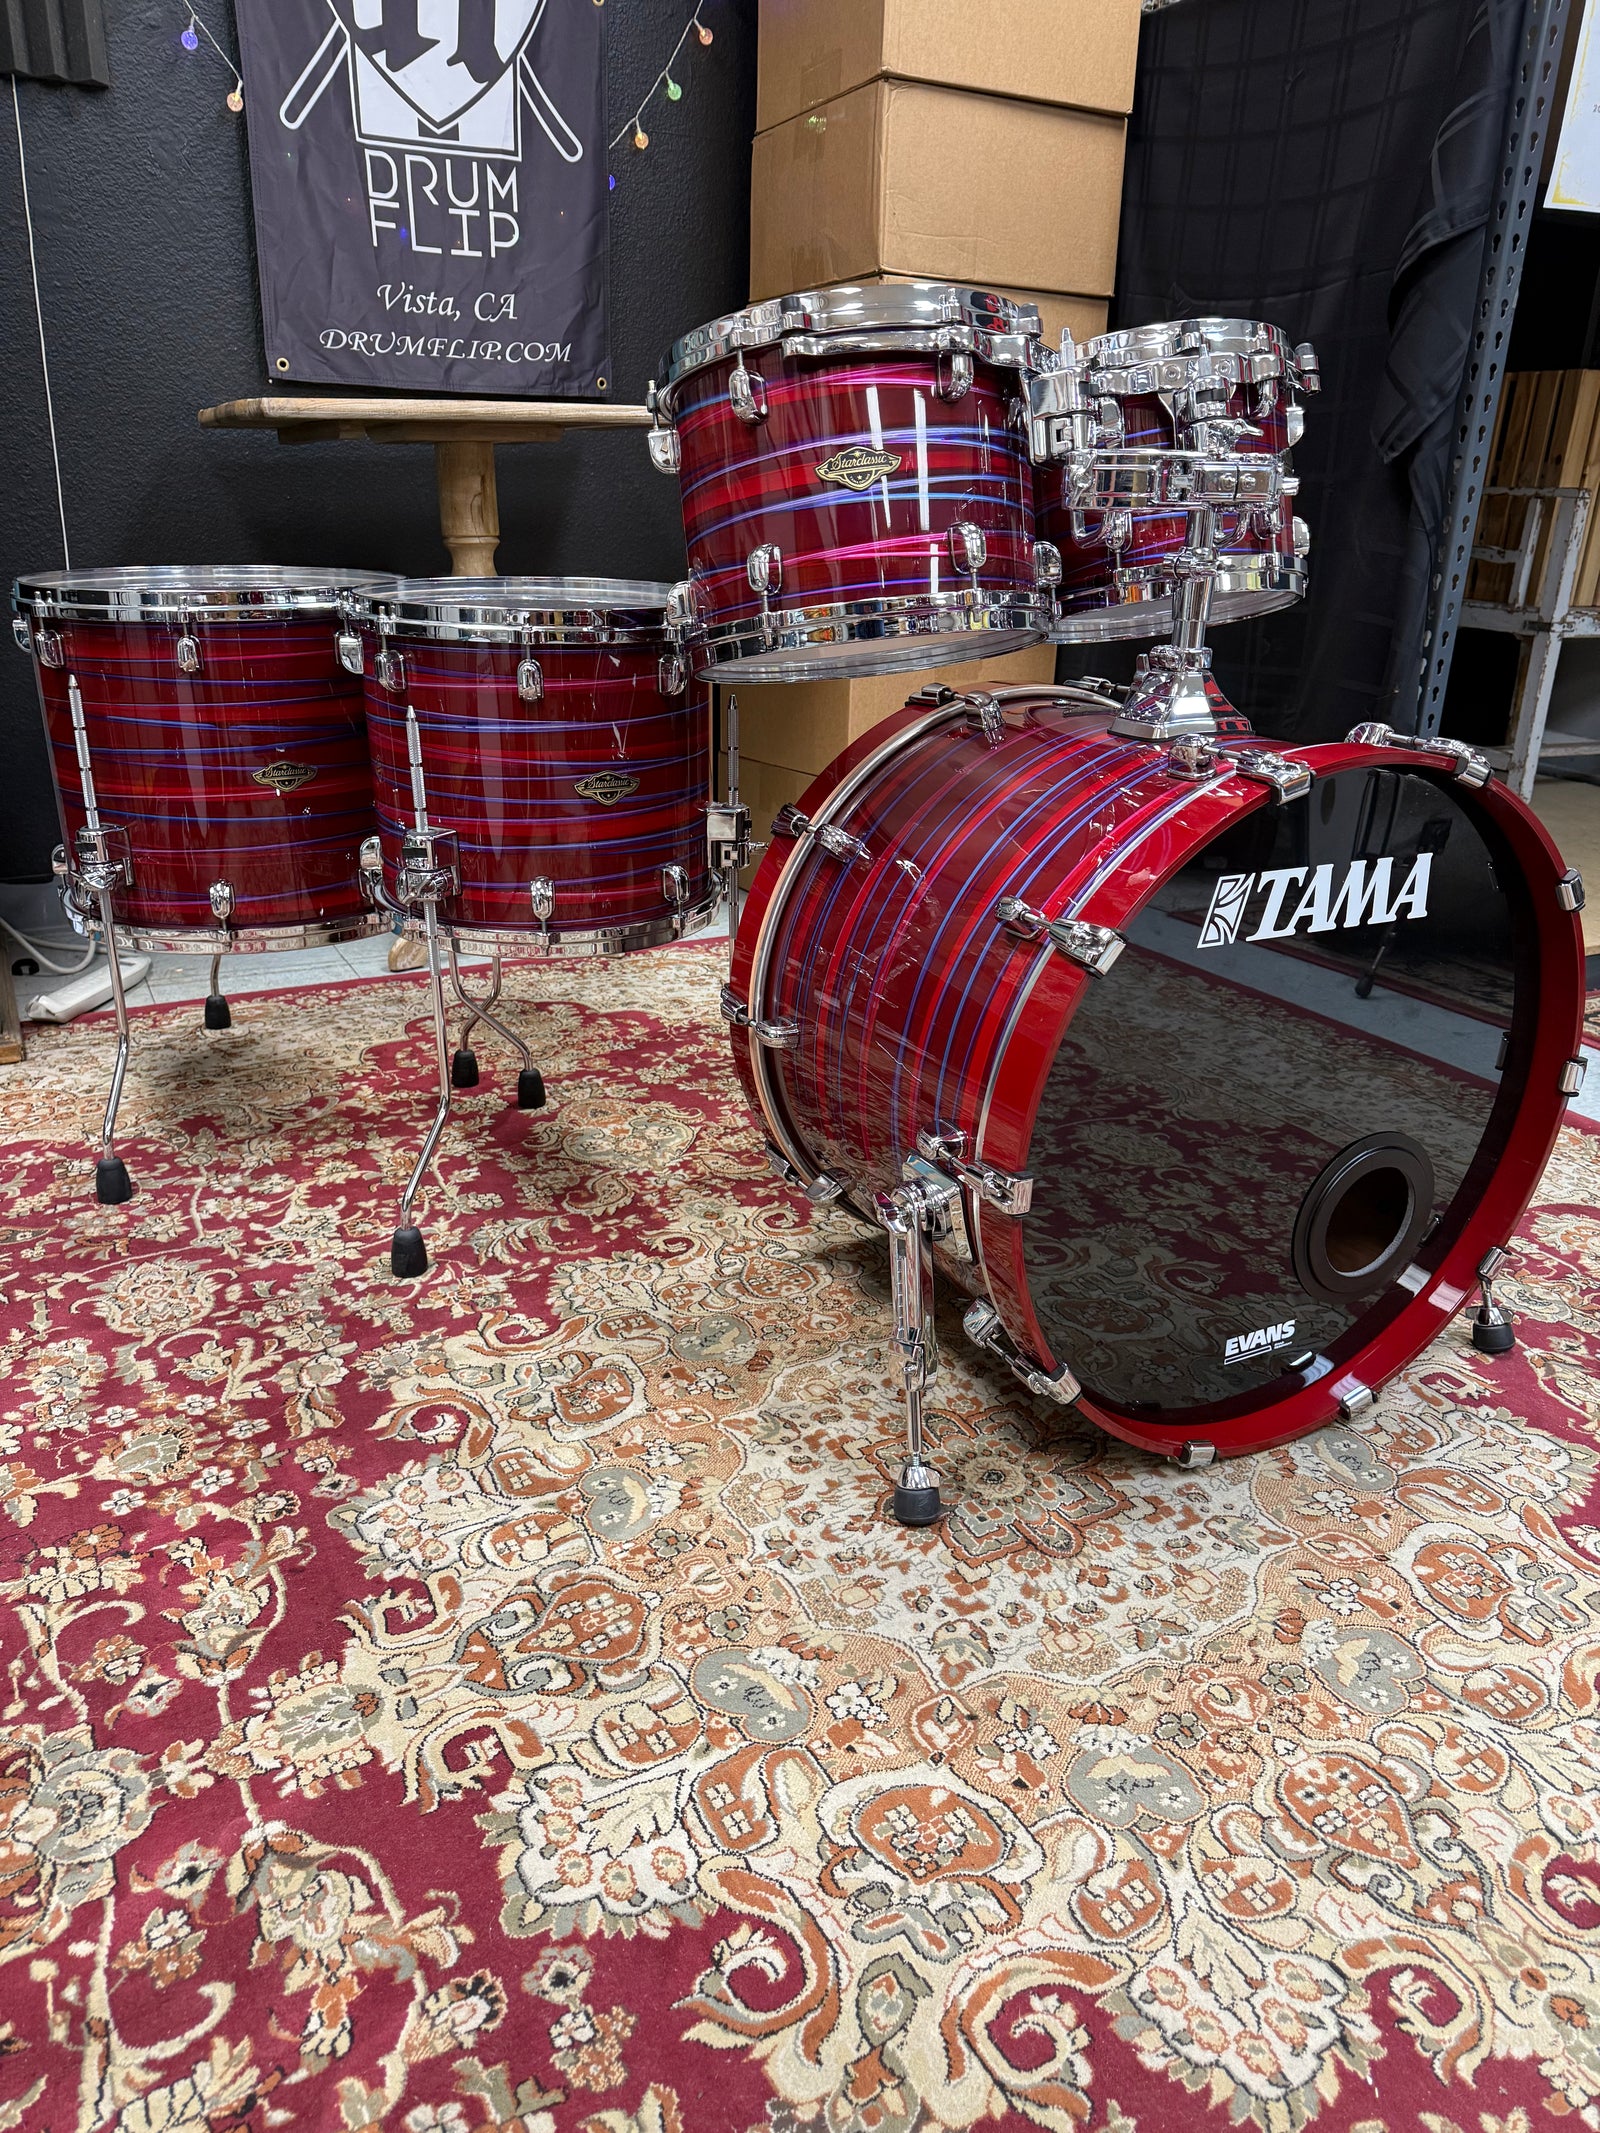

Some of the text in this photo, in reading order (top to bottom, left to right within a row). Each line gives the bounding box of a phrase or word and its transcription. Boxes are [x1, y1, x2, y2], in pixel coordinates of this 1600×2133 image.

[364, 148, 519, 213] DRUM
[369, 199, 520, 258] FLIP
[376, 282, 518, 321] Vista, CA
[319, 328, 572, 363] DRUMFLIP.COM
[830, 453, 887, 470] Starclassic
[587, 777, 630, 788] Starclassic
[1246, 852, 1433, 941] TAMA
[1225, 1318, 1297, 1357] EVANS
